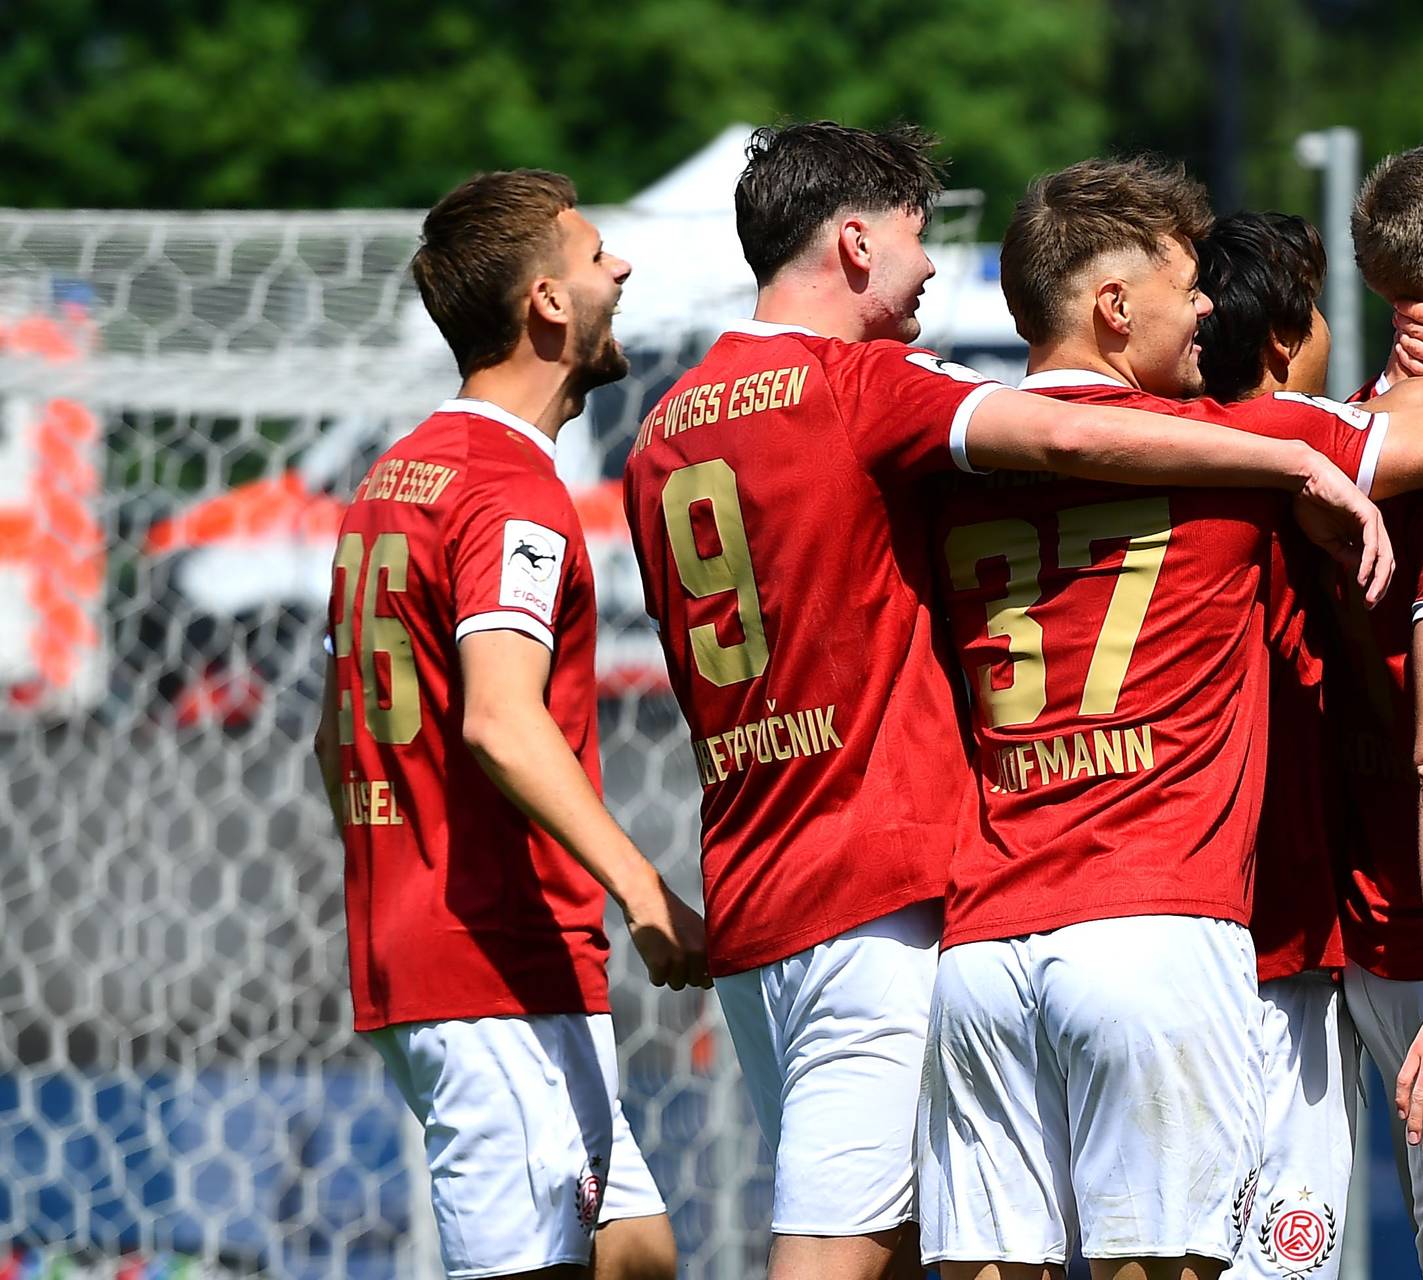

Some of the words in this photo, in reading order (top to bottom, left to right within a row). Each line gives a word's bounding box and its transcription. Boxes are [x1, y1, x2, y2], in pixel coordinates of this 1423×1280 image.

[727, 365, 809, 420] ESSEN
[394, 461, 458, 505] ESSEN
[662, 457, 770, 688] 9
[333, 532, 423, 746] 26
[944, 496, 1172, 729] 37
[990, 725, 1154, 794] OFMANN
[342, 770, 404, 825] ÜSEL
